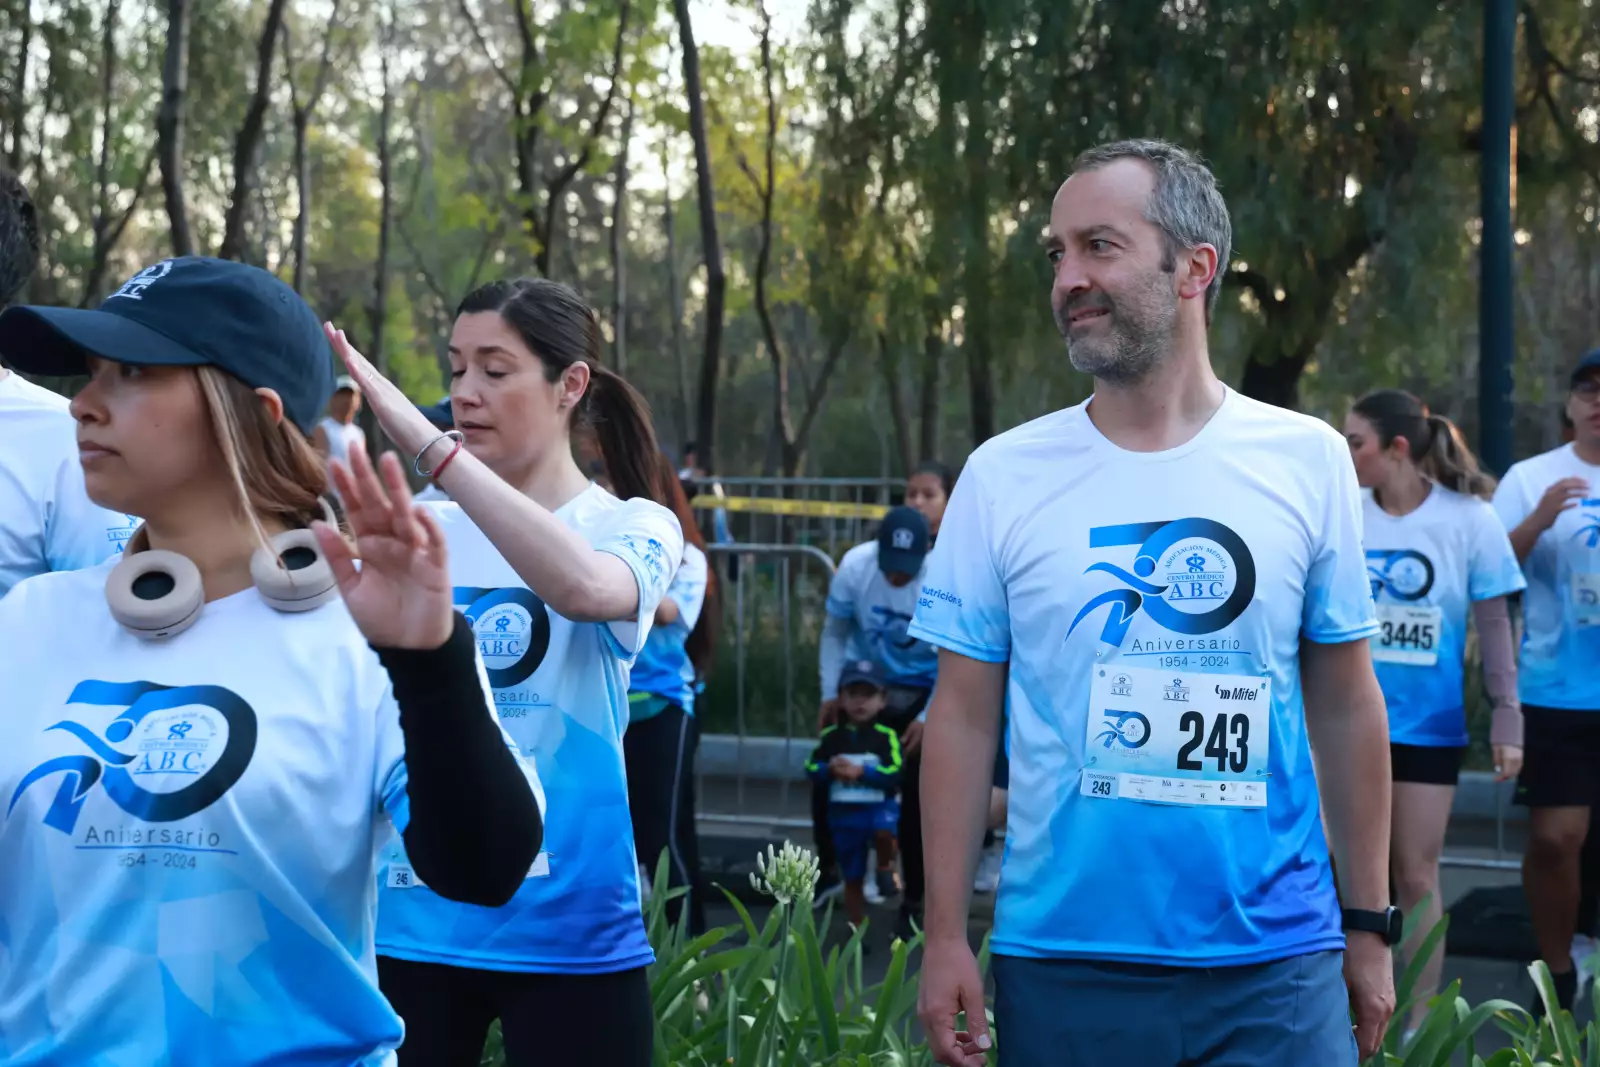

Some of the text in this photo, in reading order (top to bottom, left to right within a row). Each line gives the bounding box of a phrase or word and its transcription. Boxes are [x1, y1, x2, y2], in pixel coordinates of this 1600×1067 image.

[1168, 582, 1224, 598] ABC
[1381, 621, 1434, 650] 3445
[479, 640, 520, 655] ABC
[1131, 637, 1240, 652] Aniversario
[1159, 656, 1188, 667] 1954
[1200, 655, 1230, 667] 2024
[493, 690, 539, 702] rsario
[1232, 687, 1258, 701] Mifel
[502, 708, 527, 718] 2024
[1176, 710, 1250, 773] 243
[136, 750, 202, 771] ABC
[1091, 780, 1111, 796] 243
[85, 825, 220, 847] Aniersario
[163, 852, 196, 869] 2024
